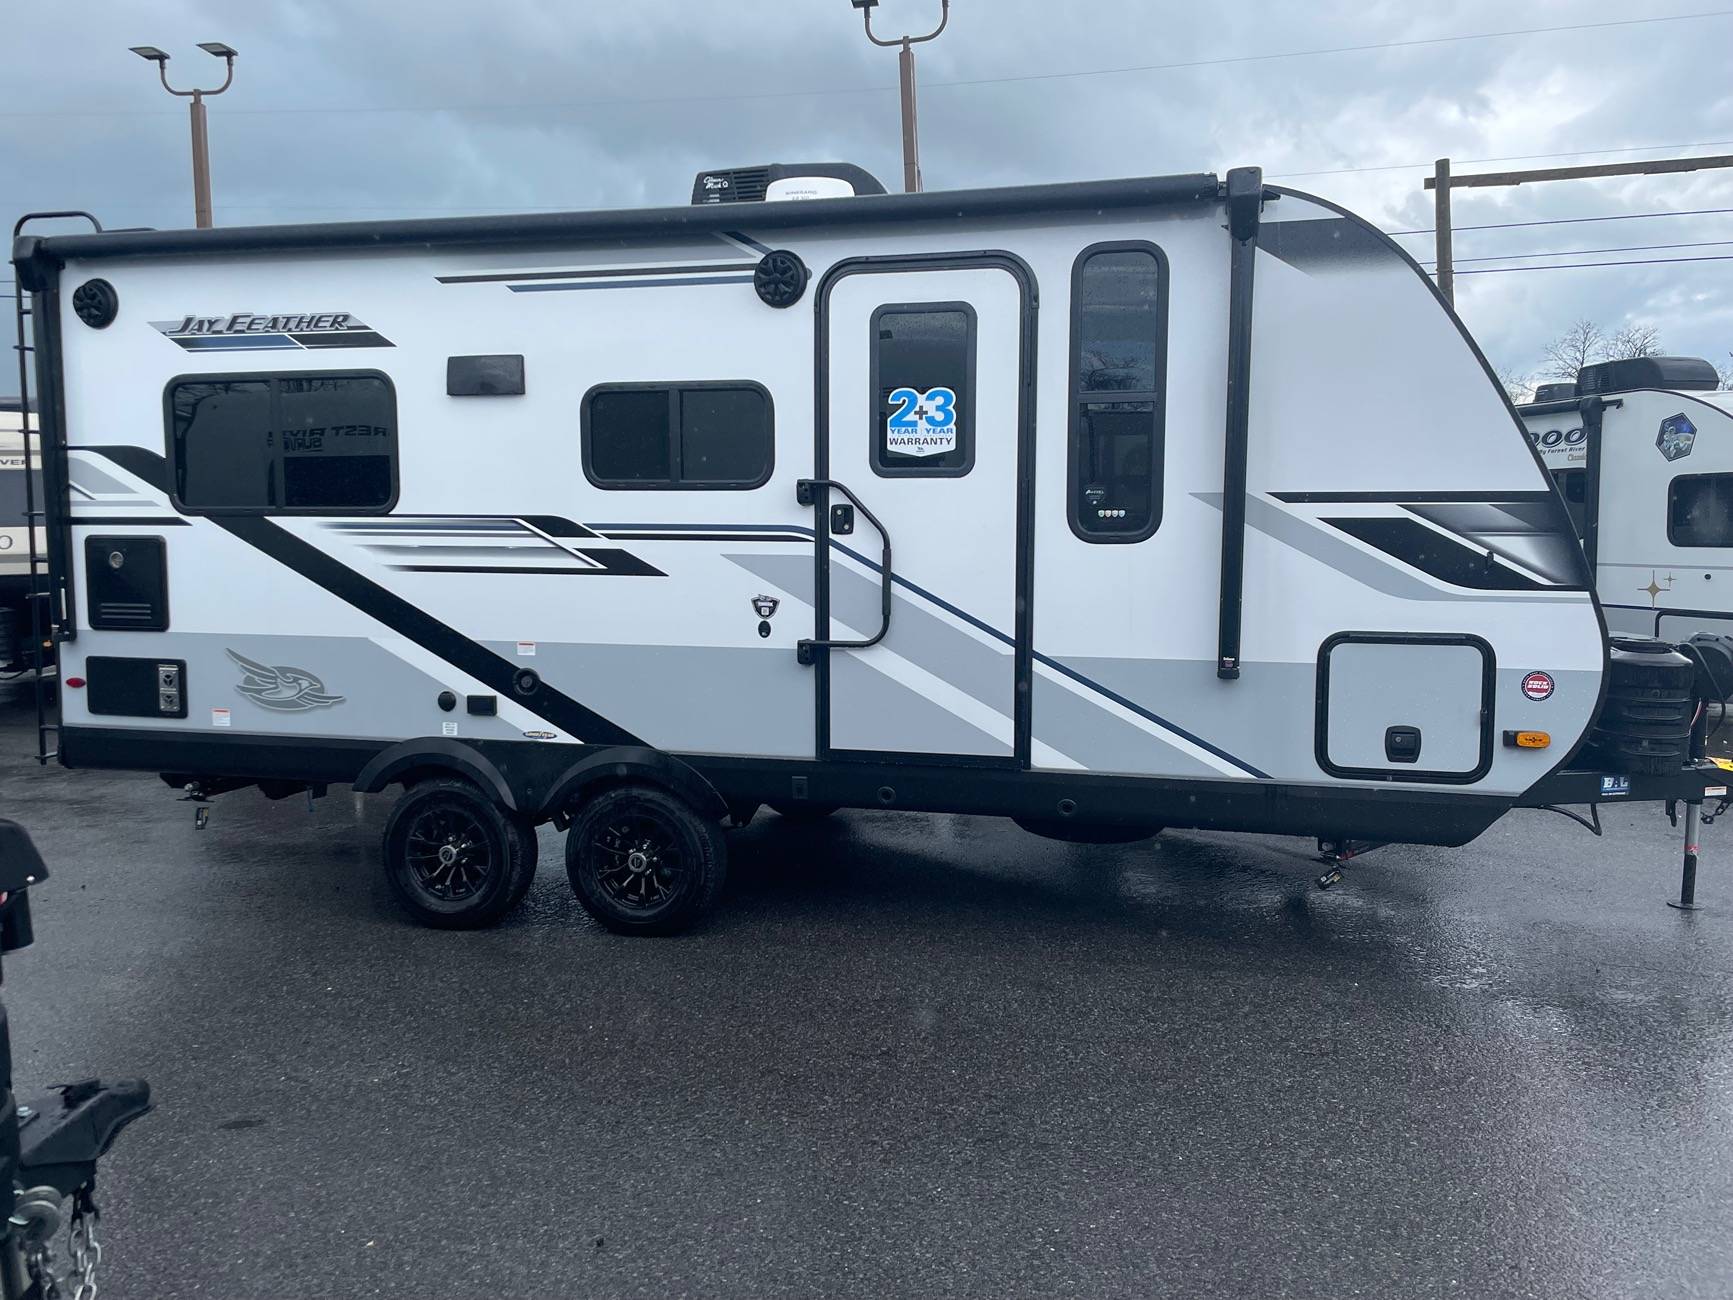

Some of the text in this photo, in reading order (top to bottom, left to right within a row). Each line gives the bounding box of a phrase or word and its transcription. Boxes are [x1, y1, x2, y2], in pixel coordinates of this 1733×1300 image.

[166, 312, 350, 335] JAY FEATHER
[889, 437, 953, 446] WARRANTY
